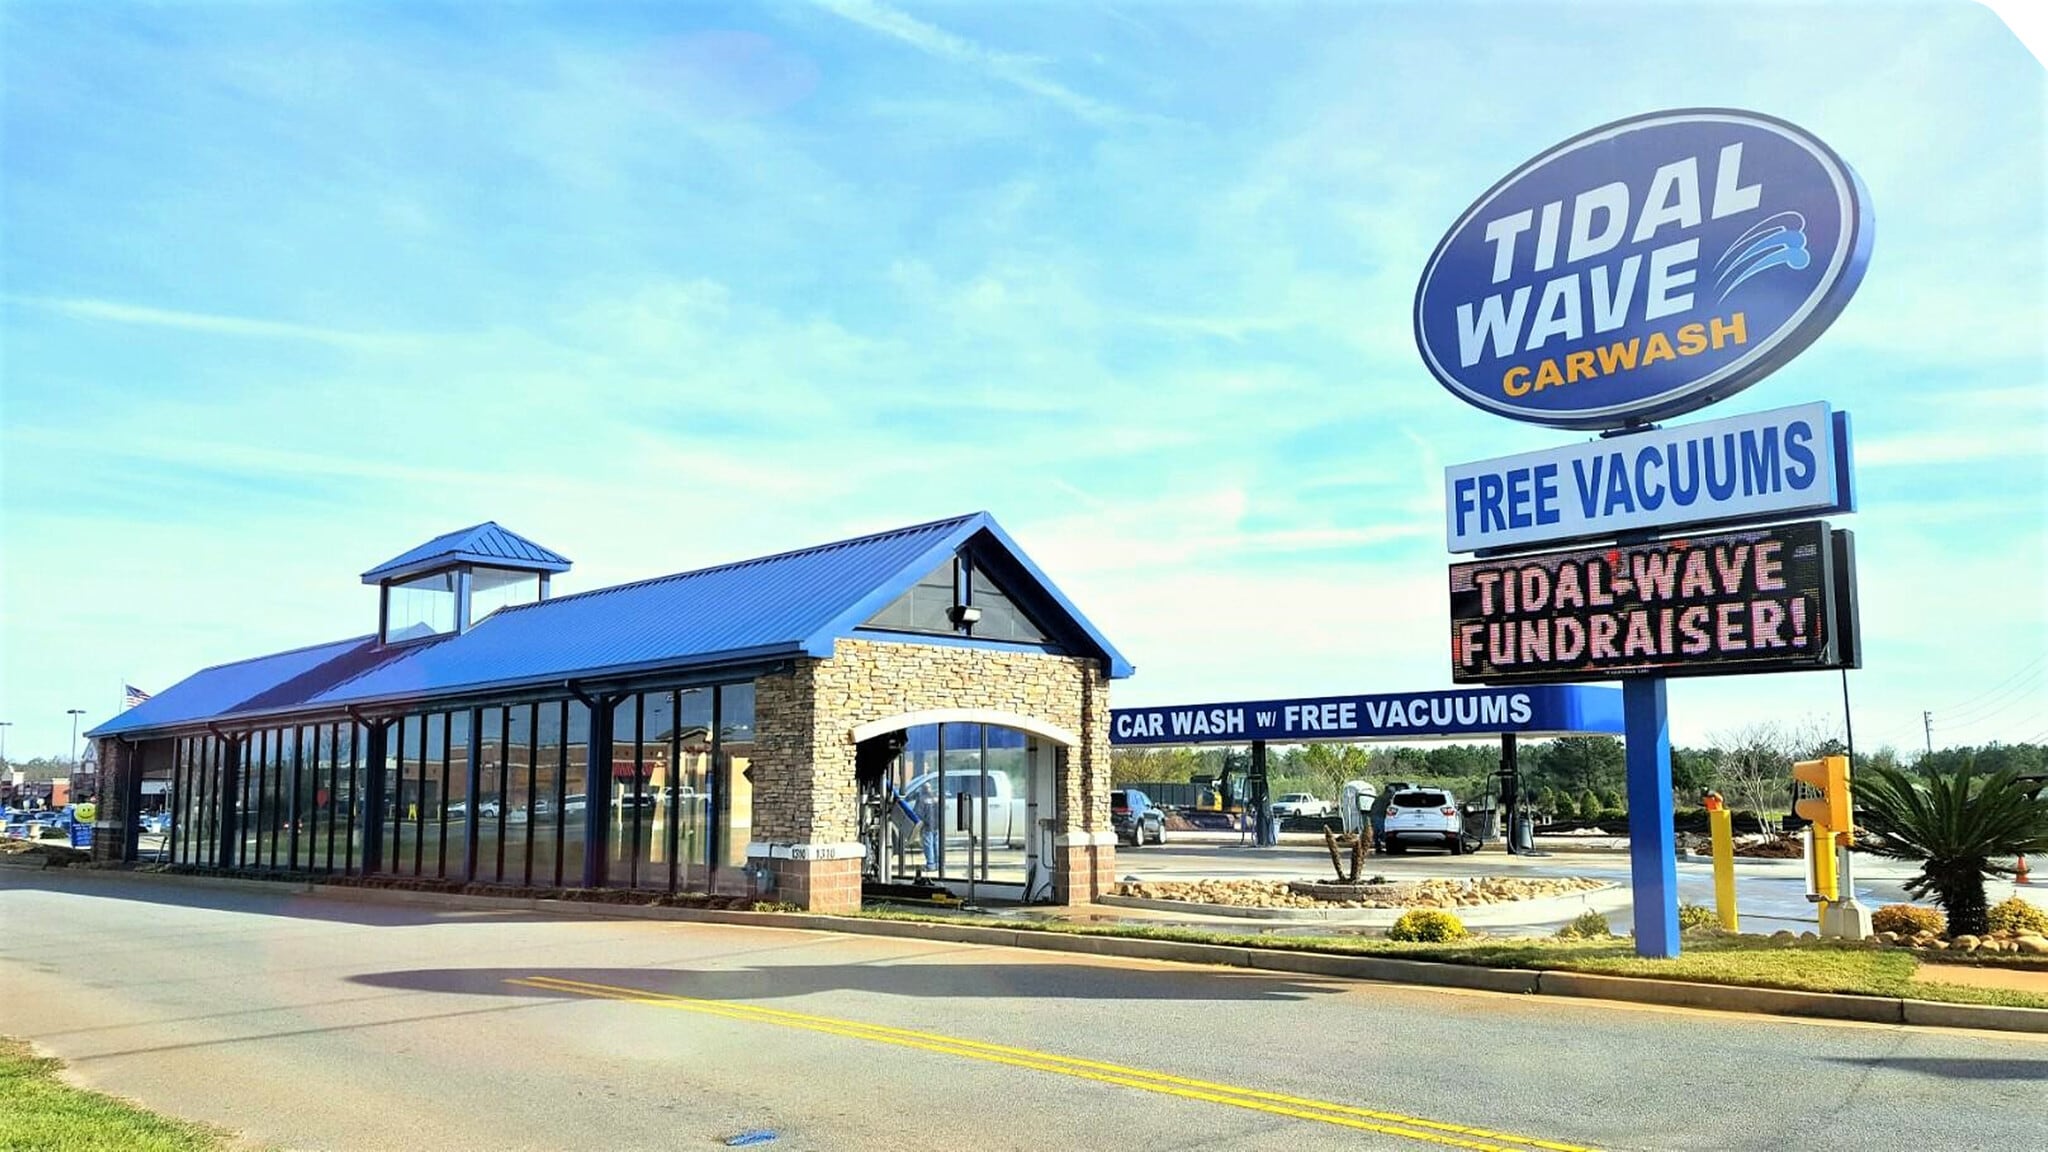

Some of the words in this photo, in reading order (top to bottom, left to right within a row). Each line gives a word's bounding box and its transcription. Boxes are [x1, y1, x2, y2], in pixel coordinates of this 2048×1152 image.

[1484, 141, 1762, 285] TIDAL
[1456, 238, 1700, 368] WAVE
[1502, 313, 1747, 397] CARWASH
[1454, 463, 1560, 537] FREE
[1572, 420, 1817, 519] VACUUMS
[1633, 541, 1787, 602] WAVE
[1460, 597, 1808, 668] FUNDRAISER!
[1117, 711, 1164, 738] CAR
[1171, 708, 1245, 735] WASH
[1284, 701, 1357, 731] FREE
[1367, 694, 1532, 728] VACUUMS
[816, 847, 836, 860] 1310
